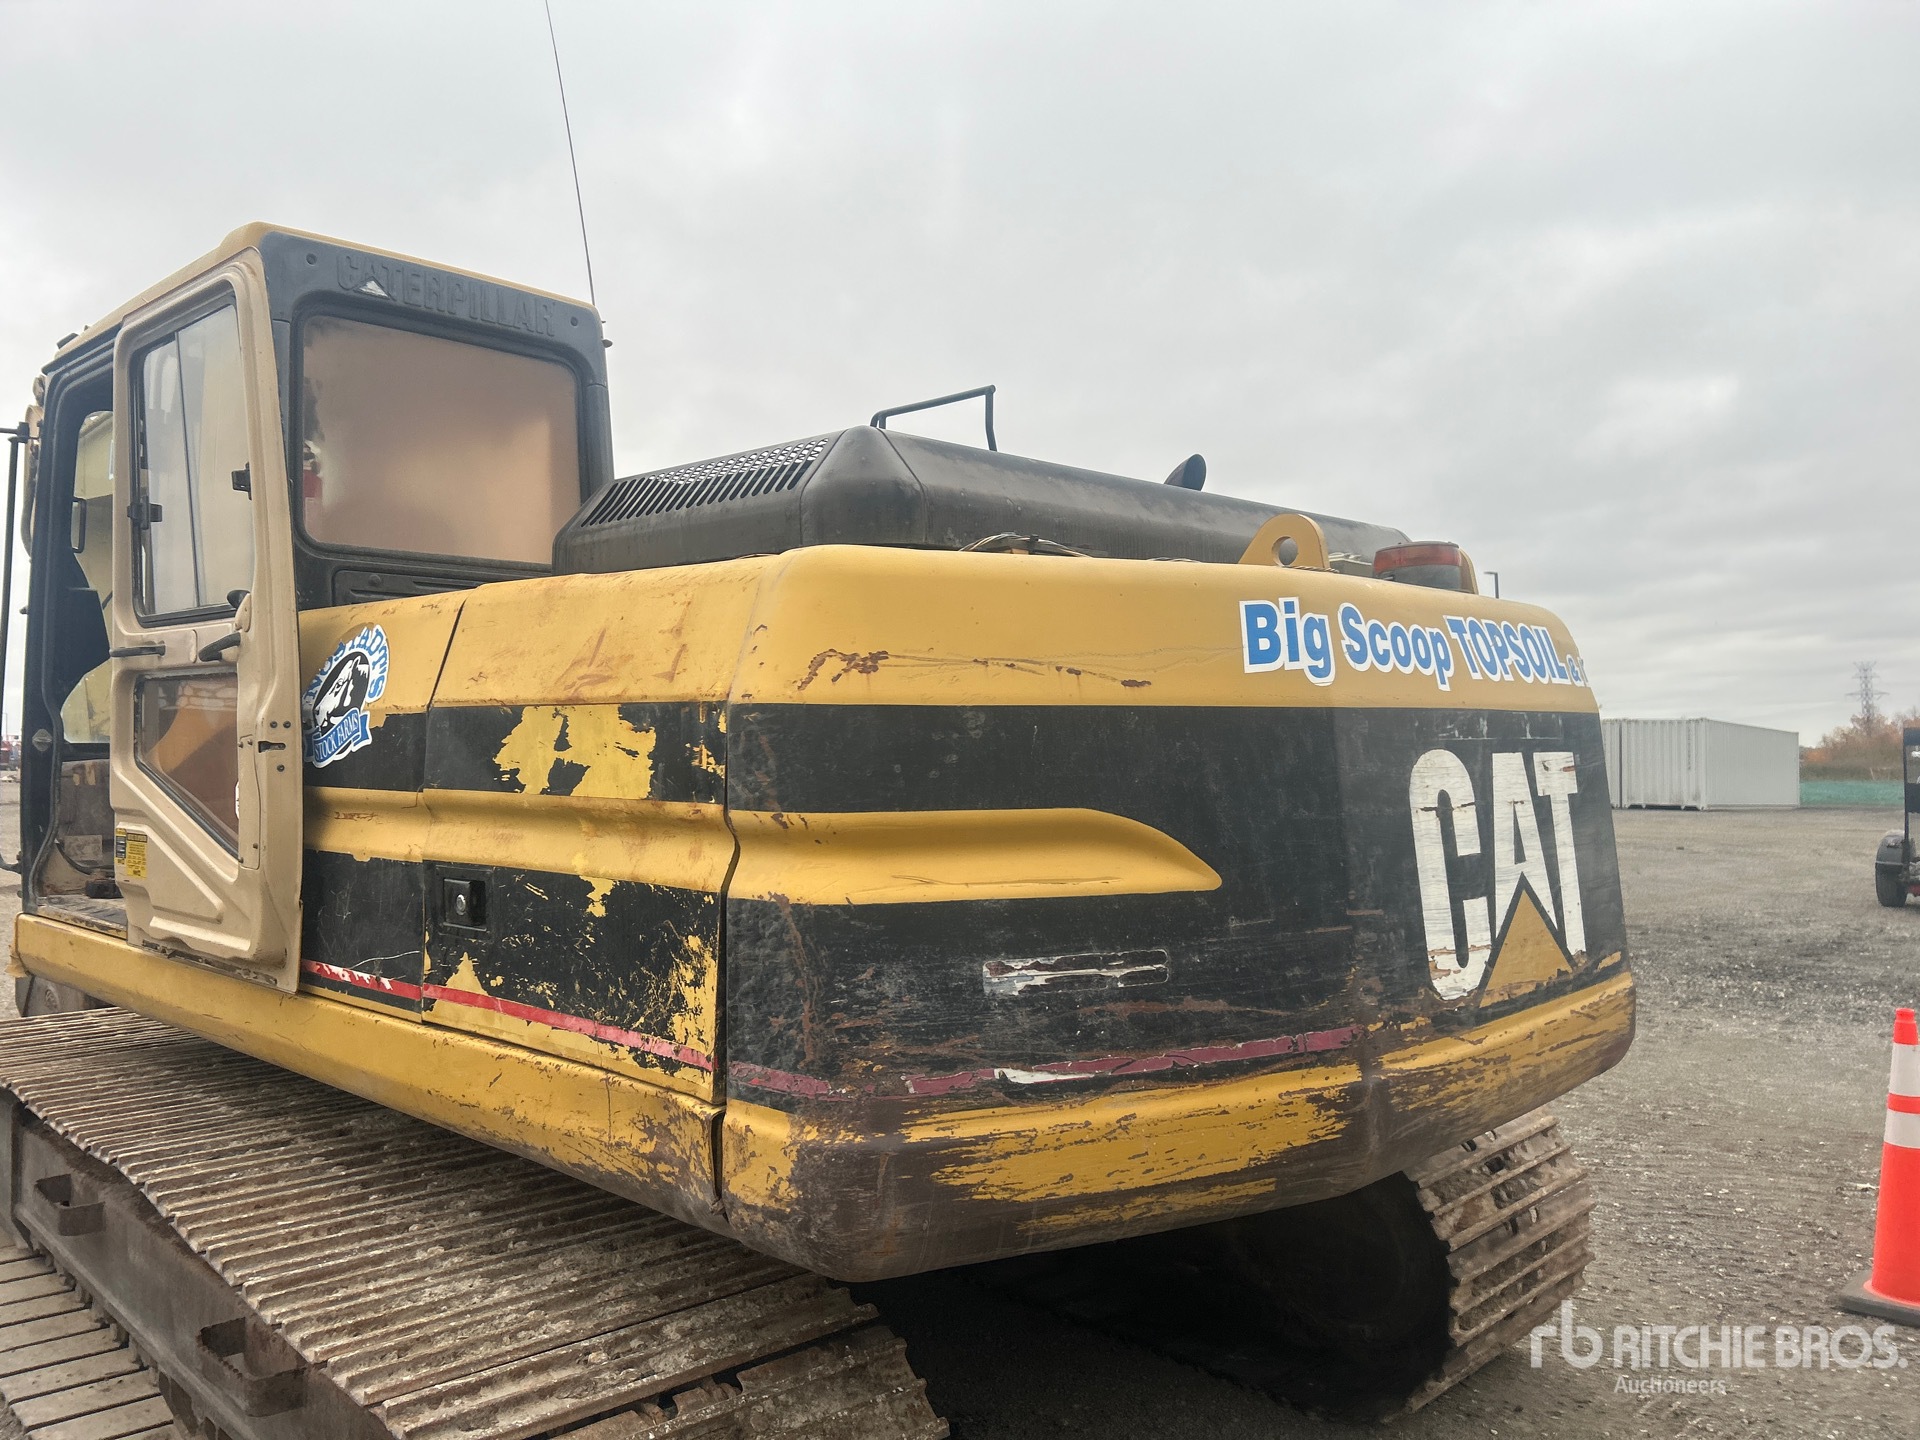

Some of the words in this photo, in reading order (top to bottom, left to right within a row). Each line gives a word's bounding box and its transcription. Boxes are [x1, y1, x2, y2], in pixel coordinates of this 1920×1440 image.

[336, 254, 555, 338] CATERPILLAR
[1241, 599, 1334, 683] Big
[1340, 604, 1453, 689] Scoop
[1445, 615, 1569, 683] TOPSOIL
[314, 731, 337, 761] STOCK
[336, 712, 359, 747] FARMS
[1409, 749, 1587, 1000] CAT
